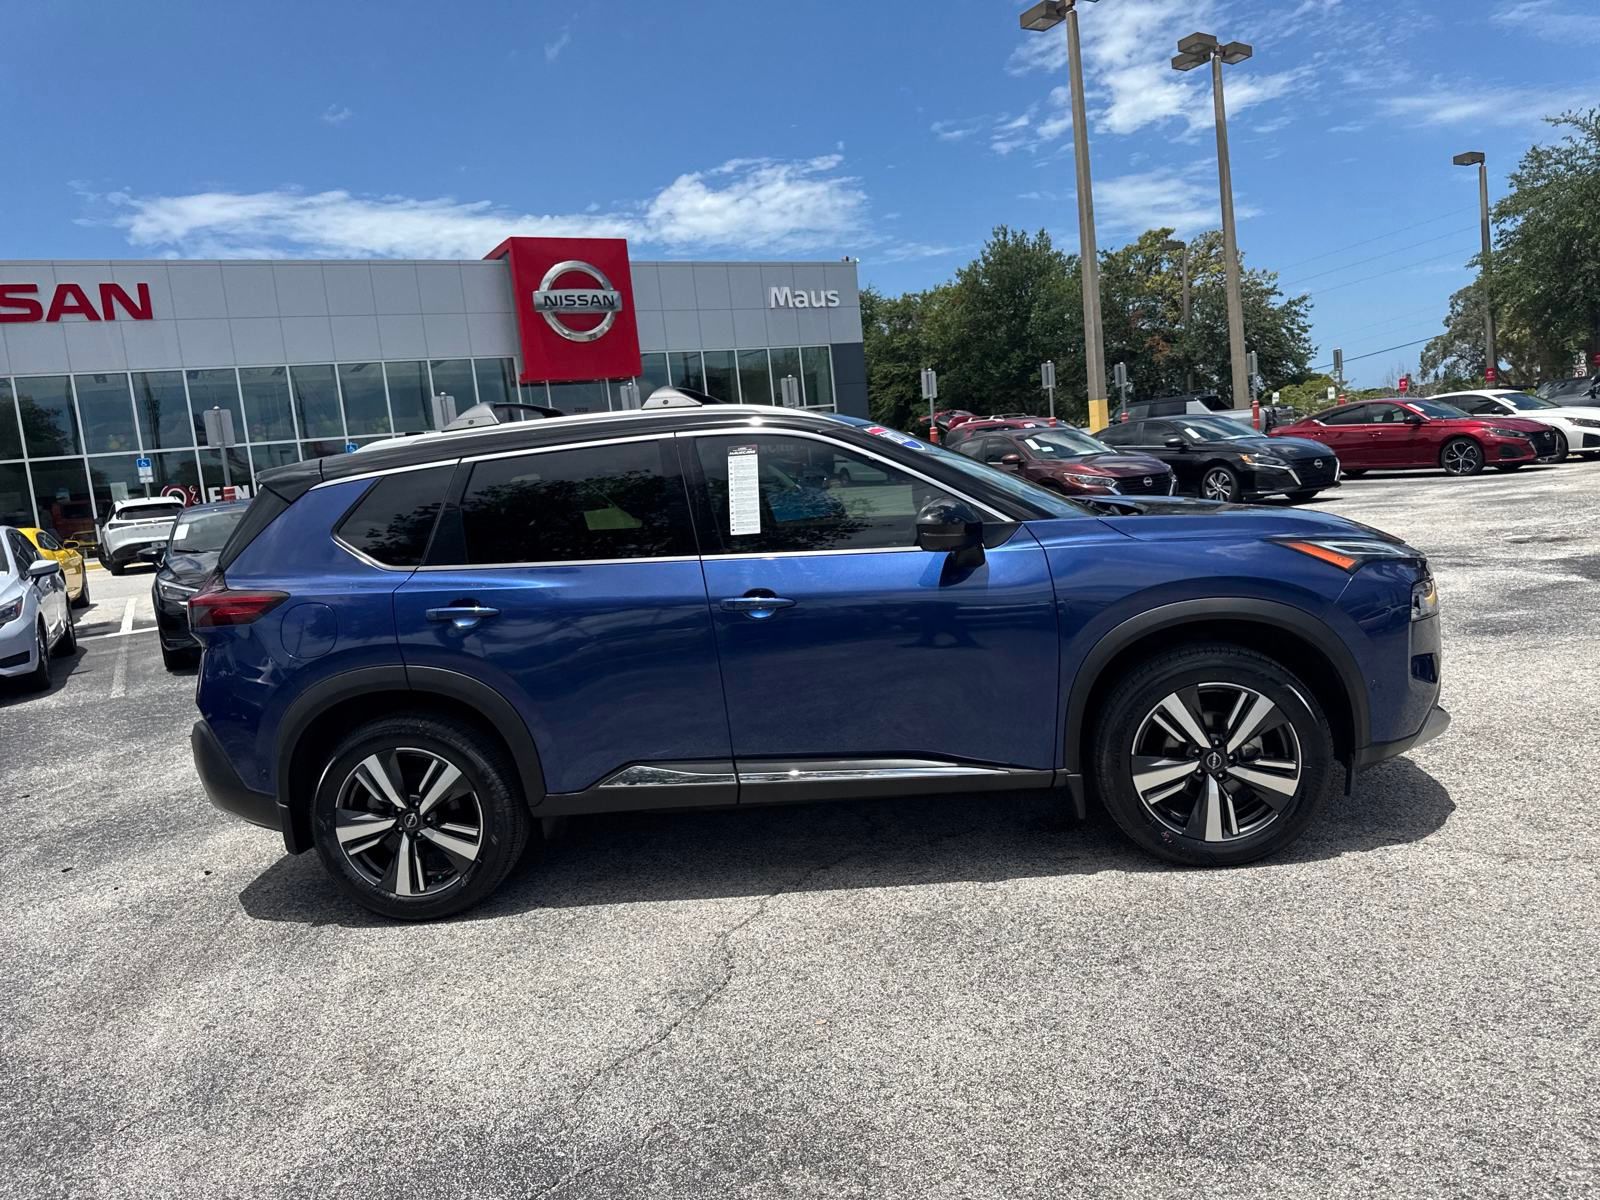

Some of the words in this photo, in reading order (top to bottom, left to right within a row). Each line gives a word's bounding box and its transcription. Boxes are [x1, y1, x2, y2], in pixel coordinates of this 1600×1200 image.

[0, 283, 153, 322] SAN
[543, 294, 615, 307] NISSAN
[769, 286, 840, 308] Maus
